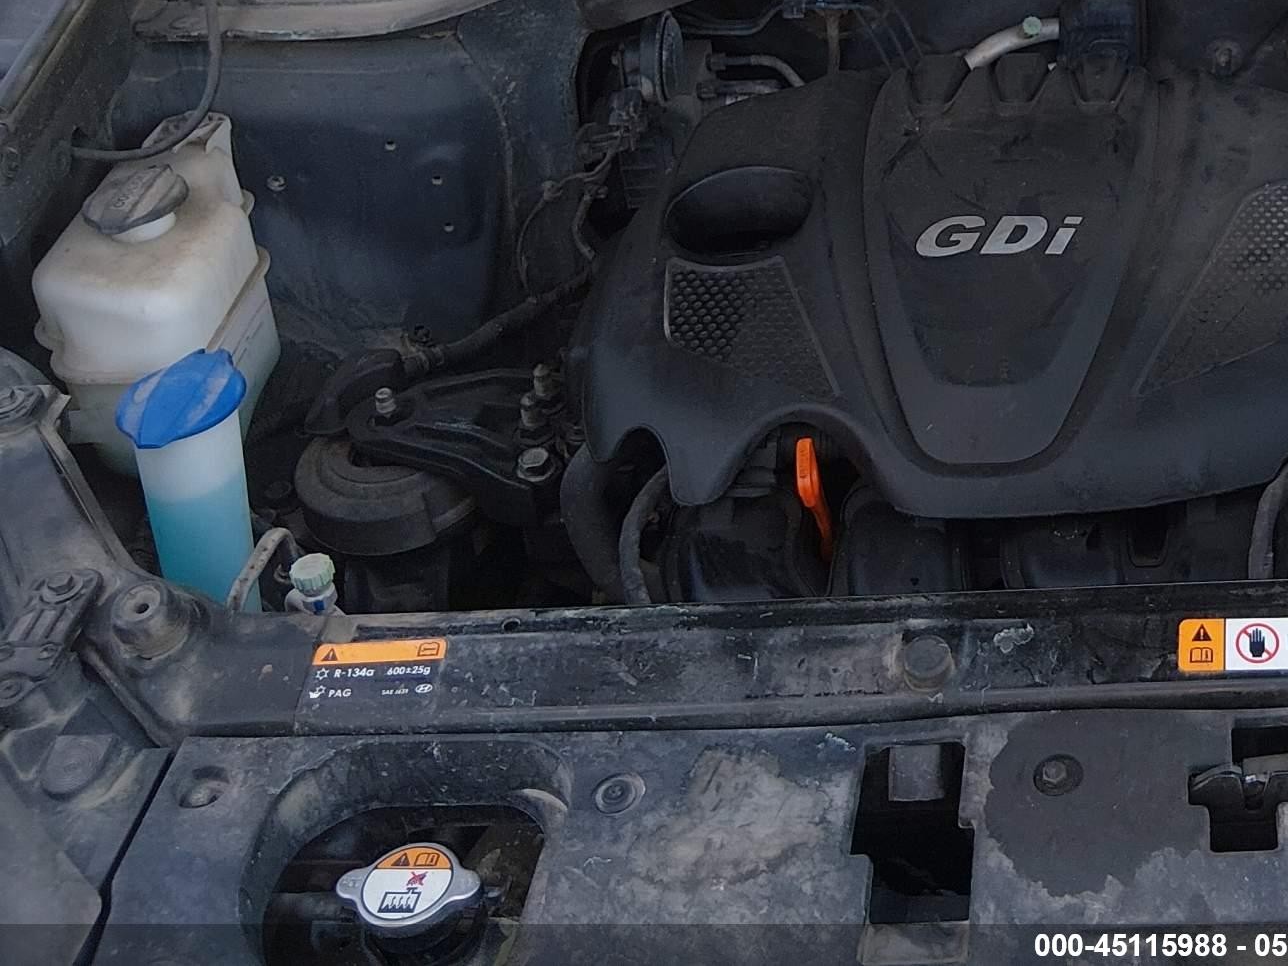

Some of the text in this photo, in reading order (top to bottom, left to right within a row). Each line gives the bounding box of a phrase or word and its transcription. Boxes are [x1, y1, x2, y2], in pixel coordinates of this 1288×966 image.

[915, 215, 1083, 257] GDi
[334, 665, 431, 678] R-134a 600±25g
[328, 688, 352, 698] PAG
